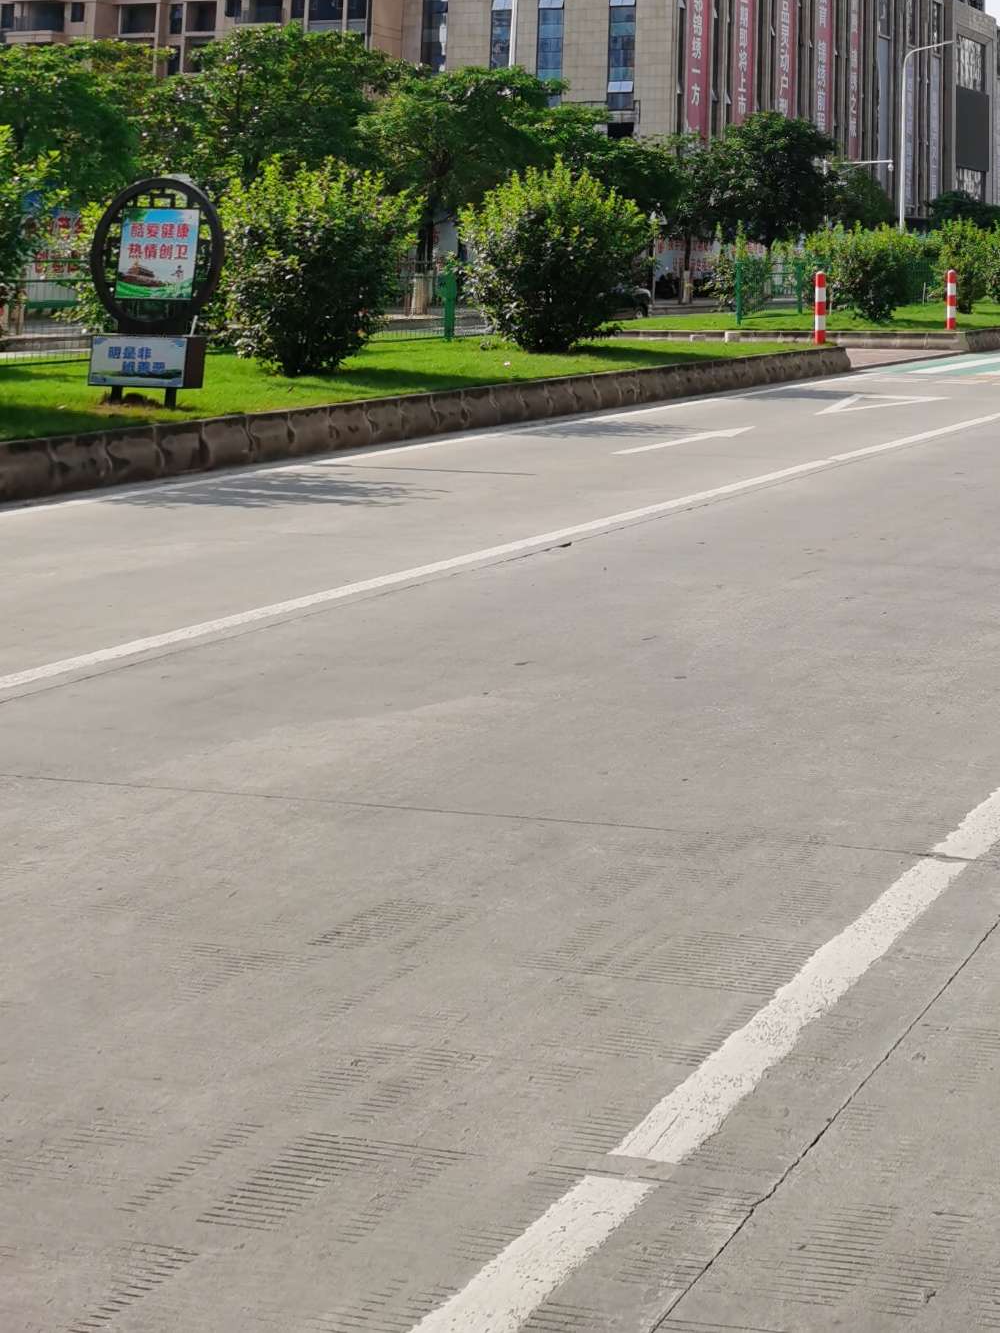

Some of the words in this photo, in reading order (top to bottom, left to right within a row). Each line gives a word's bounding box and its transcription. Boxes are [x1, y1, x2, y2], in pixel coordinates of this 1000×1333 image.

[128, 243, 189, 260] 热情创卫
[108, 346, 152, 360] 明是非
